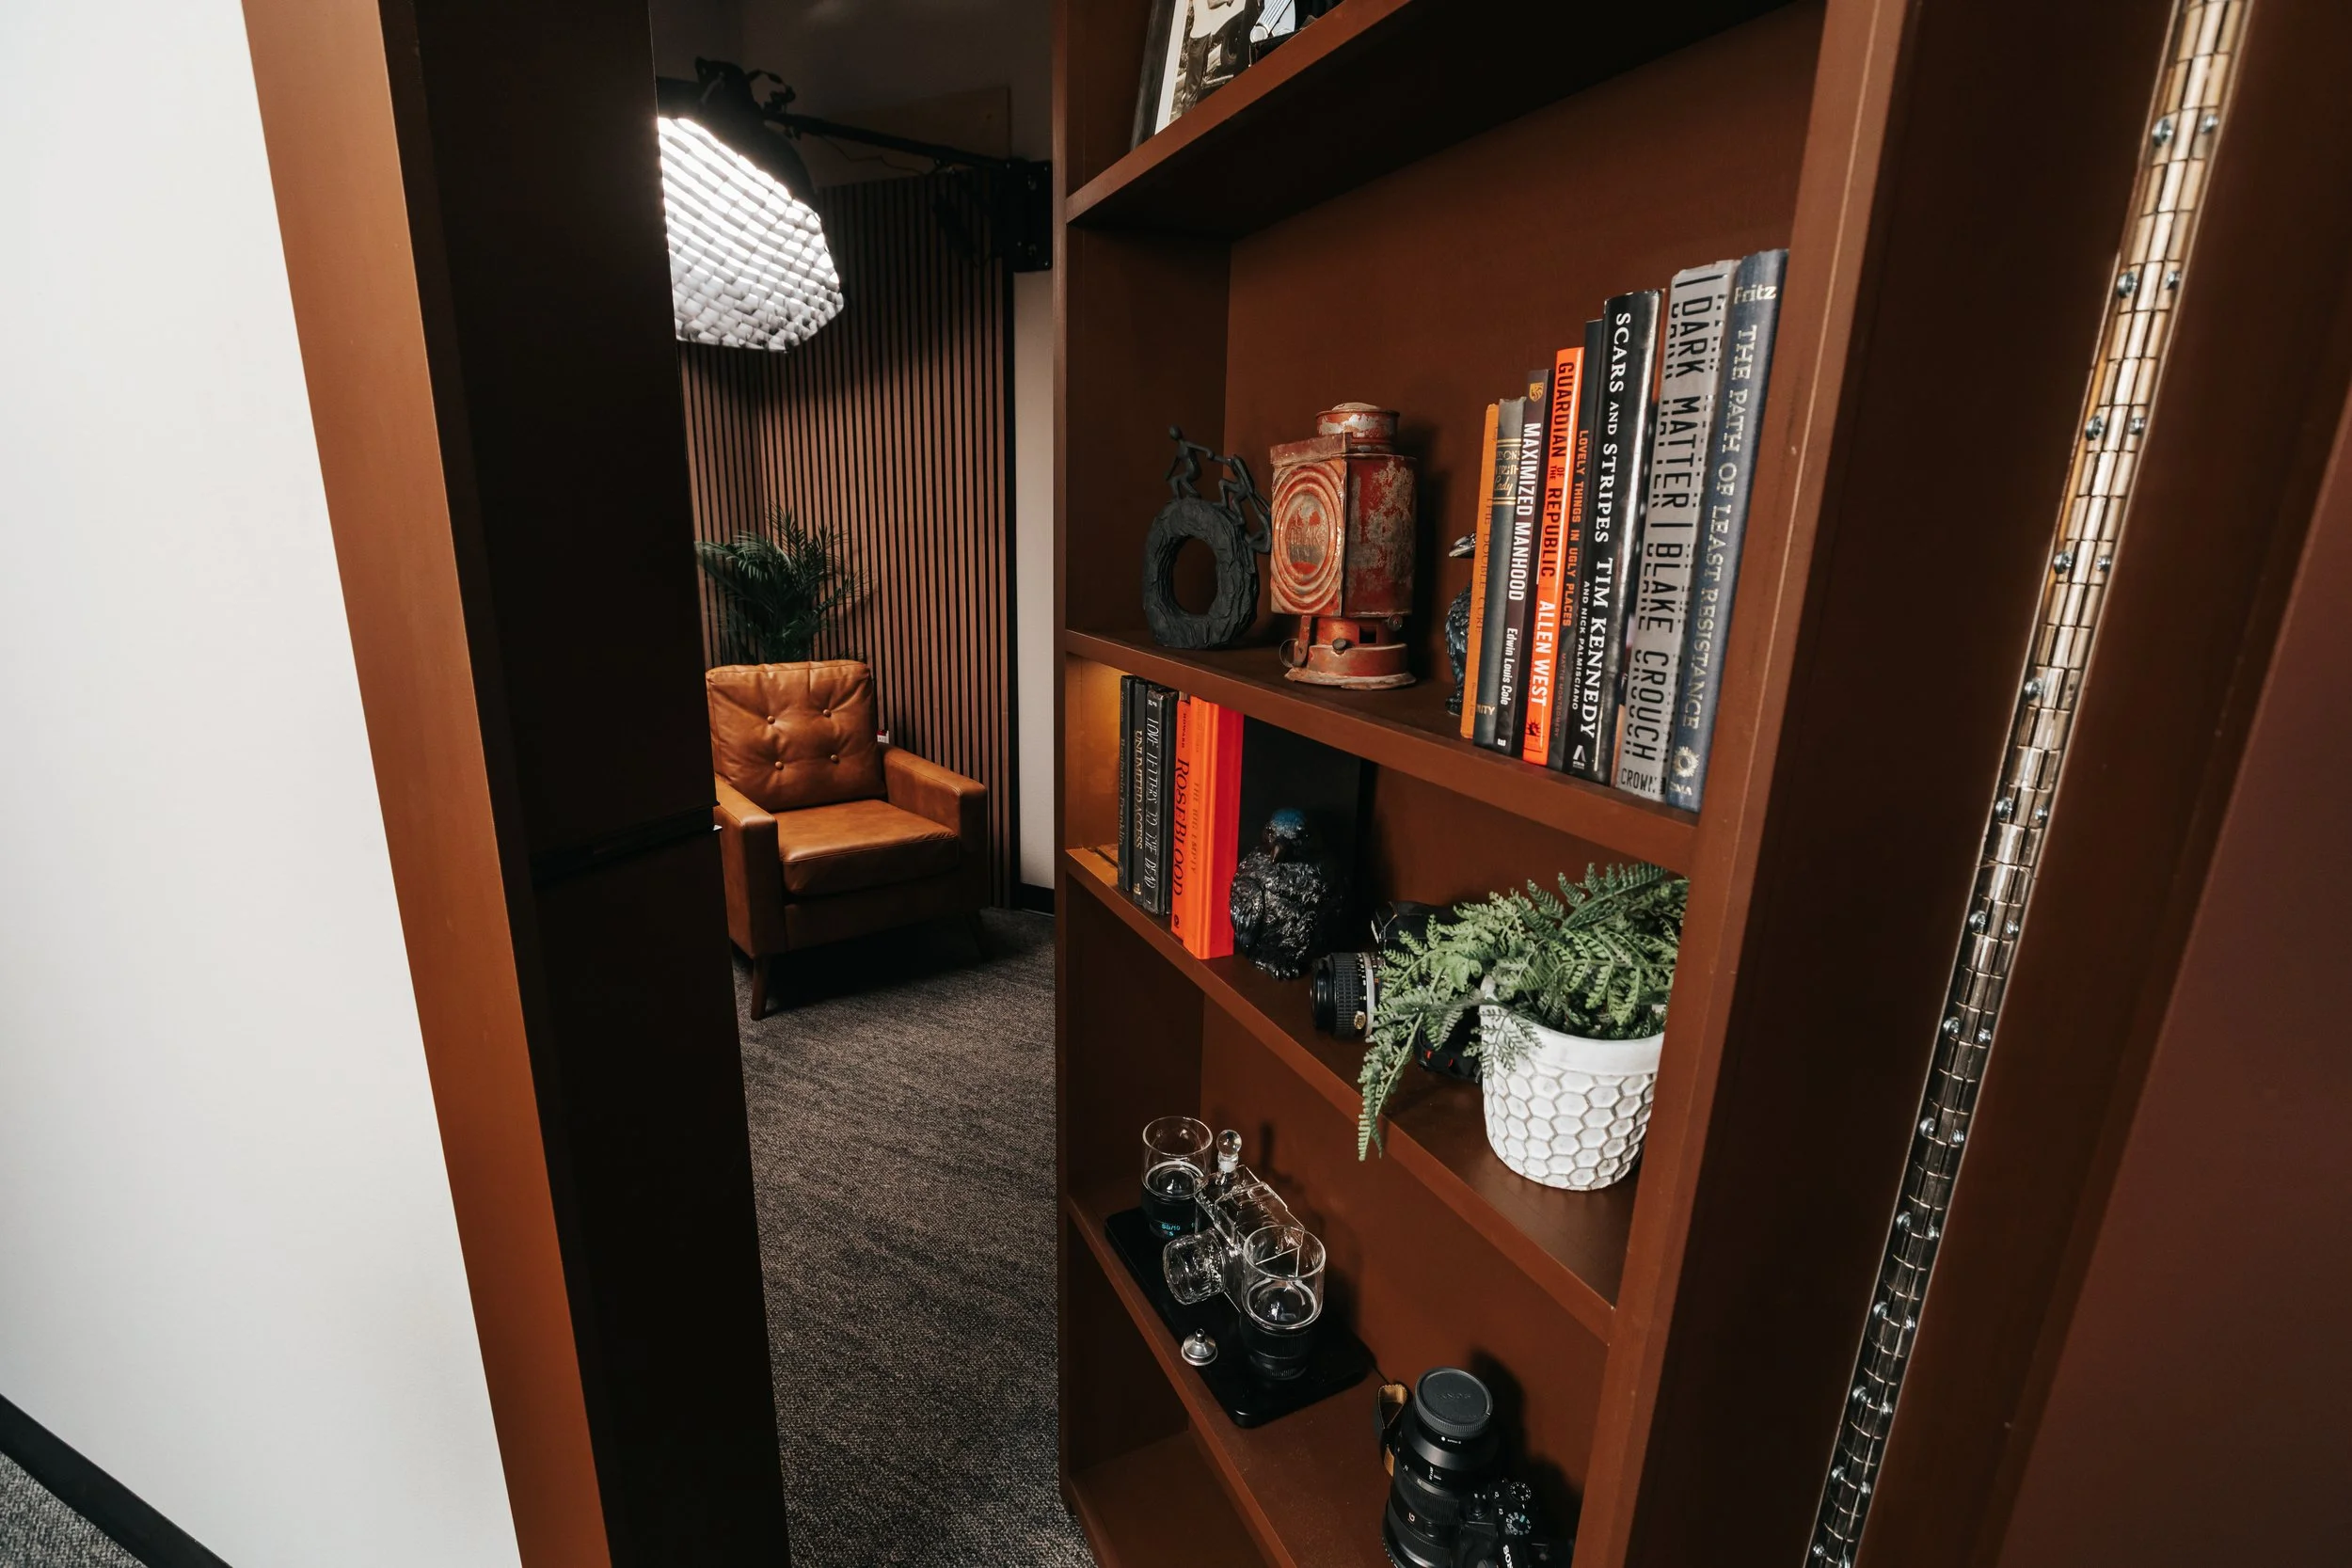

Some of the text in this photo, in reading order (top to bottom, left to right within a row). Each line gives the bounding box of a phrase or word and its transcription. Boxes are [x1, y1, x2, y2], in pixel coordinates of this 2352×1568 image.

[1549, 465, 1557, 482] THE
[1550, 361, 1575, 458] GUARDIAN
[1555, 467, 1565, 479] OF
[1594, 311, 1631, 544] SCARS AND STRIPES
[1507, 421, 1542, 602] MAXIMIZED MANHOOD
[1563, 430, 1588, 627] LOVELY THINGS IN UGLY PLACES
[1631, 295, 1713, 762] DARK MATTER BLAKE CROUCH
[1681, 325, 1757, 730] THE PATH OF LEAST RESISTANCE
[1499, 626, 1519, 706] Edwin Louis Cole
[1530, 487, 1563, 707] REPUBLIC ALLEN WEST
[1571, 580, 1591, 711] AND NICK PALMISCIANO
[1580, 557, 1614, 739] TIM KENNEDY
[1135, 729, 1143, 849] UNLIMITED ACCESS
[1147, 717, 1159, 749] LOVE
[1173, 757, 1190, 896] ROSEBLOOD
